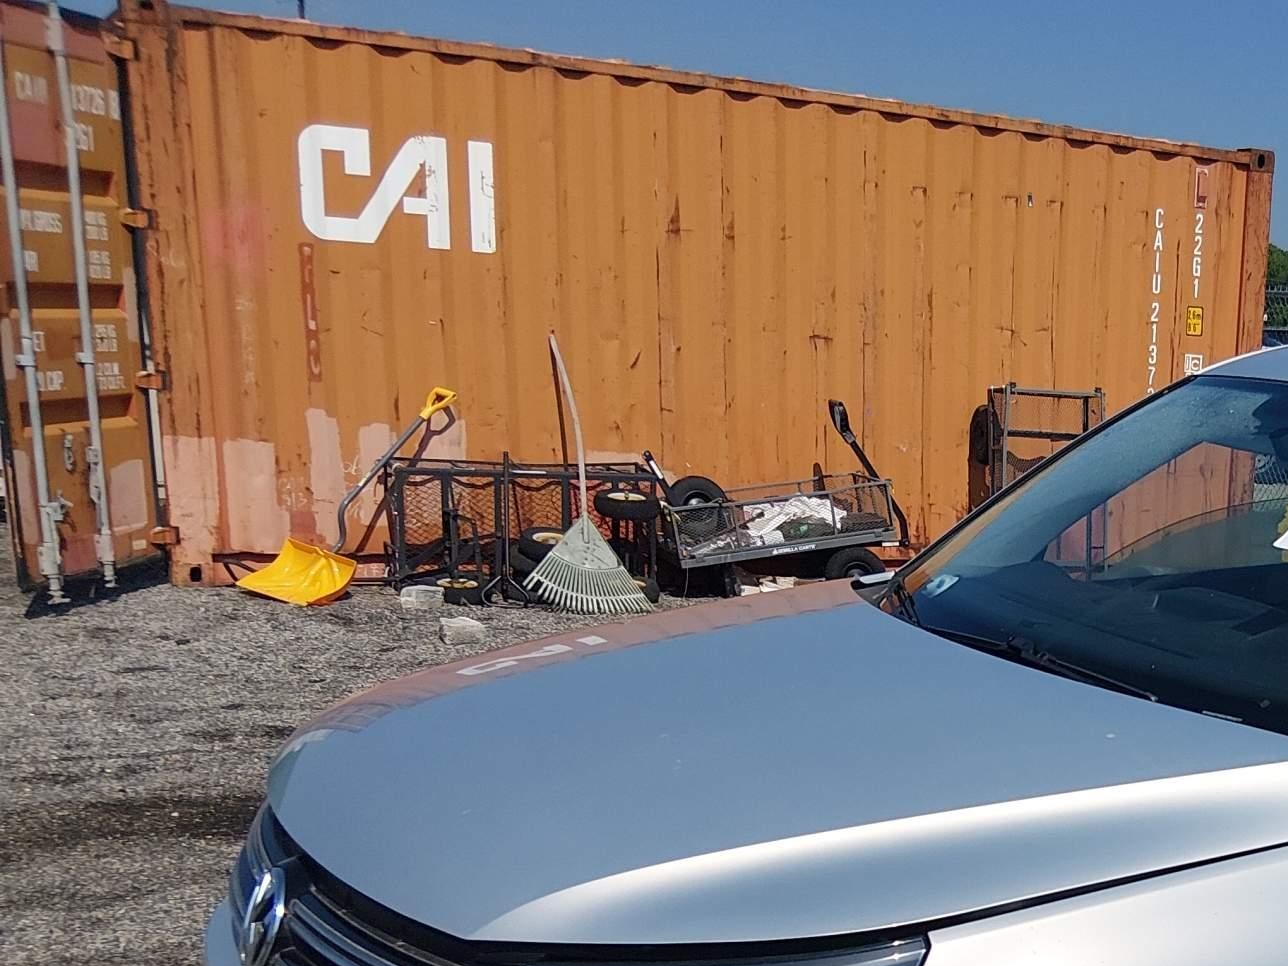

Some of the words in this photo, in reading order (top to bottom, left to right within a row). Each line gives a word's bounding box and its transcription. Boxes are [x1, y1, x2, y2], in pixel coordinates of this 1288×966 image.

[298, 124, 497, 254] CAI
[1152, 207, 1164, 295] CAIU
[1192, 212, 1204, 299] 22G1
